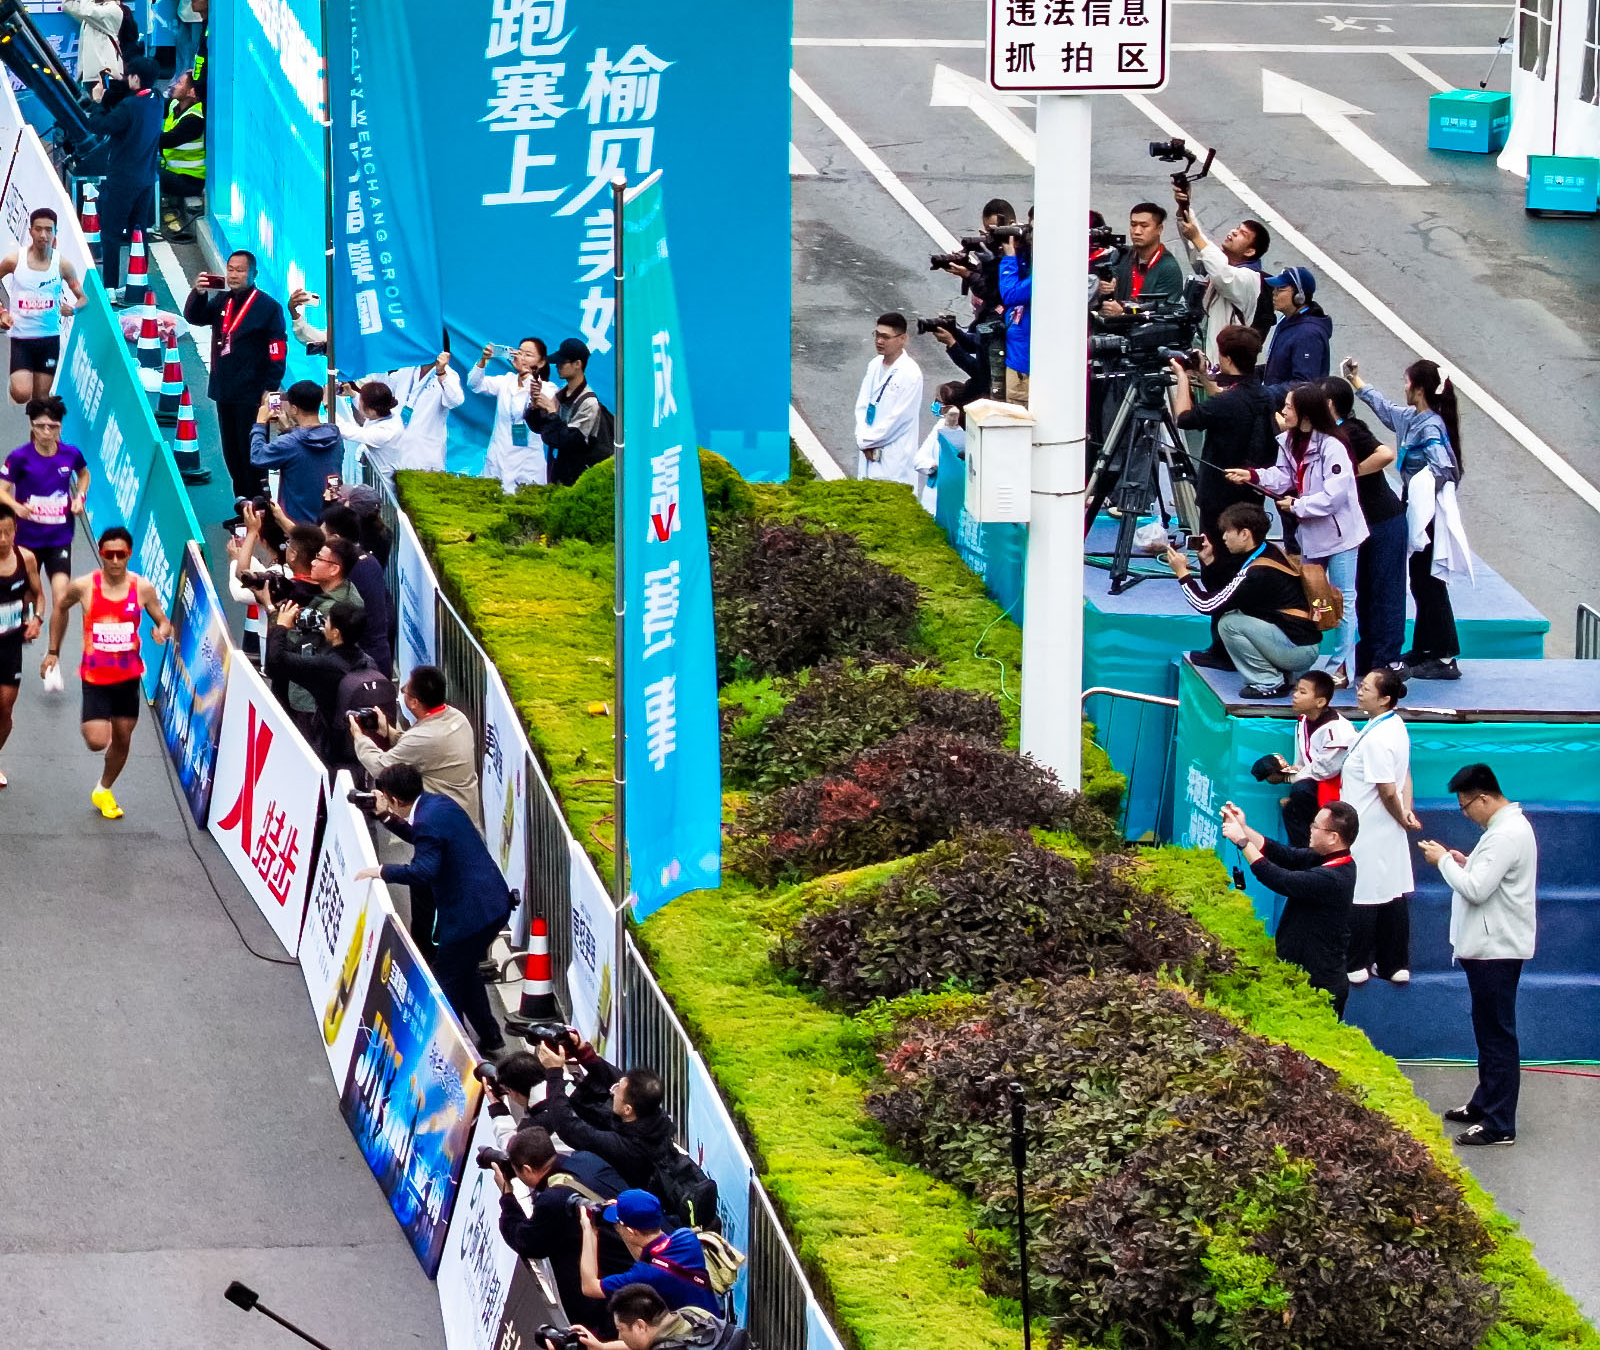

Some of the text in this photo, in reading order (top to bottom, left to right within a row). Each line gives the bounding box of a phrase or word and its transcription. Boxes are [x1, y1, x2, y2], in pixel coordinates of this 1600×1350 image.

[1005, 41, 1149, 74] 抓拍区
[356, 109, 388, 242] WENCHANG
[379, 252, 405, 329] GROUP
